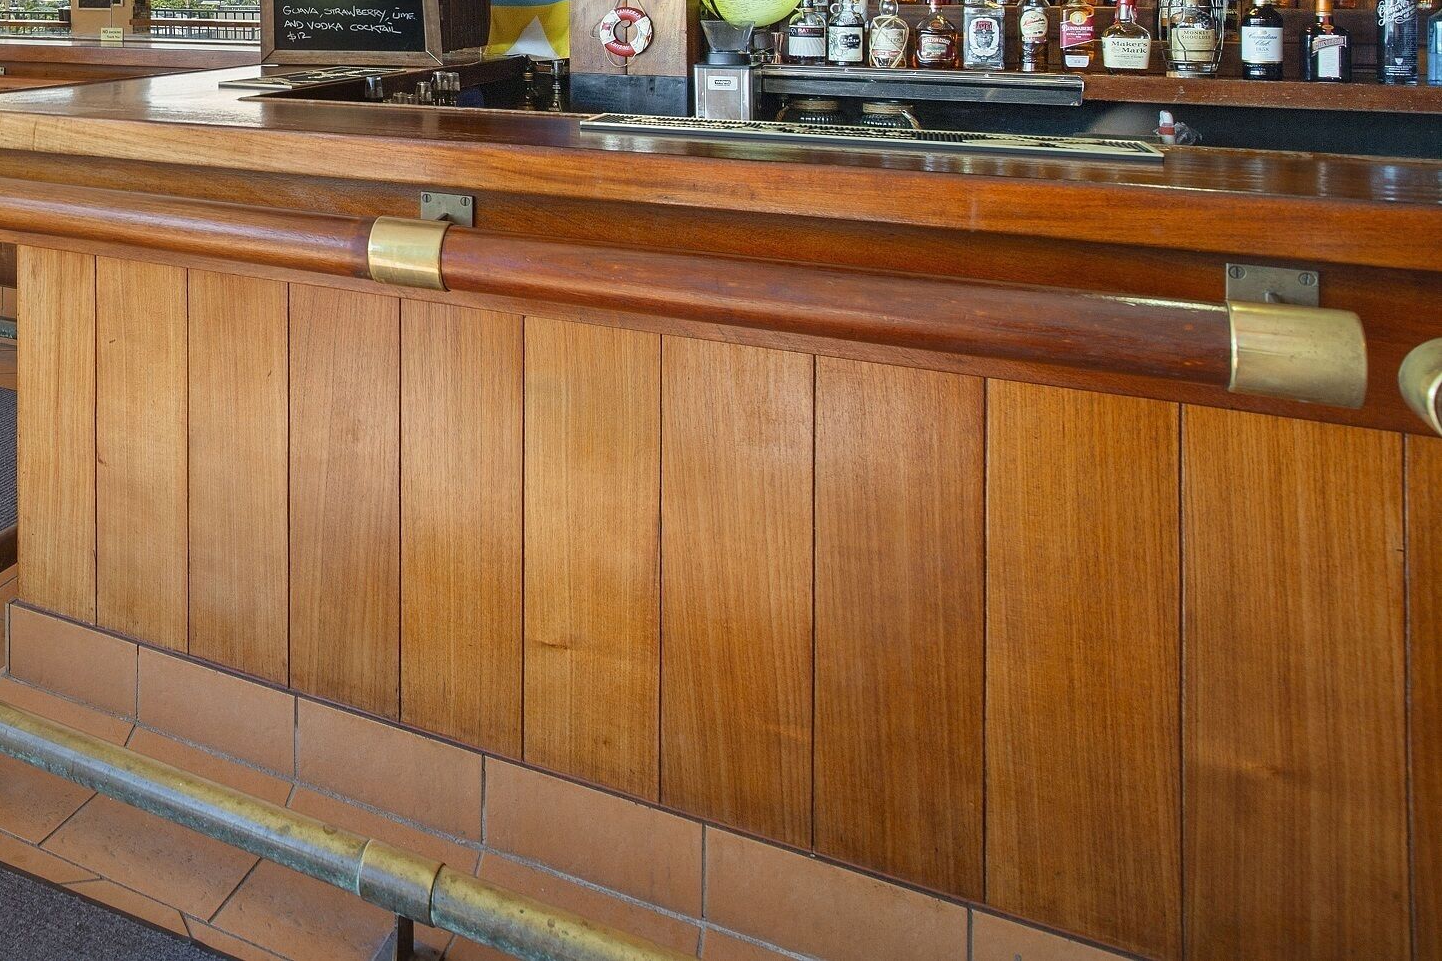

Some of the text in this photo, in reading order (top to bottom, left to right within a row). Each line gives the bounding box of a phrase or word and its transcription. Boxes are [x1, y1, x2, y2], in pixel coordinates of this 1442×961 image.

[284, 20, 402, 34] AND VODKA COCKTAIL
[286, 31, 312, 43] $12
